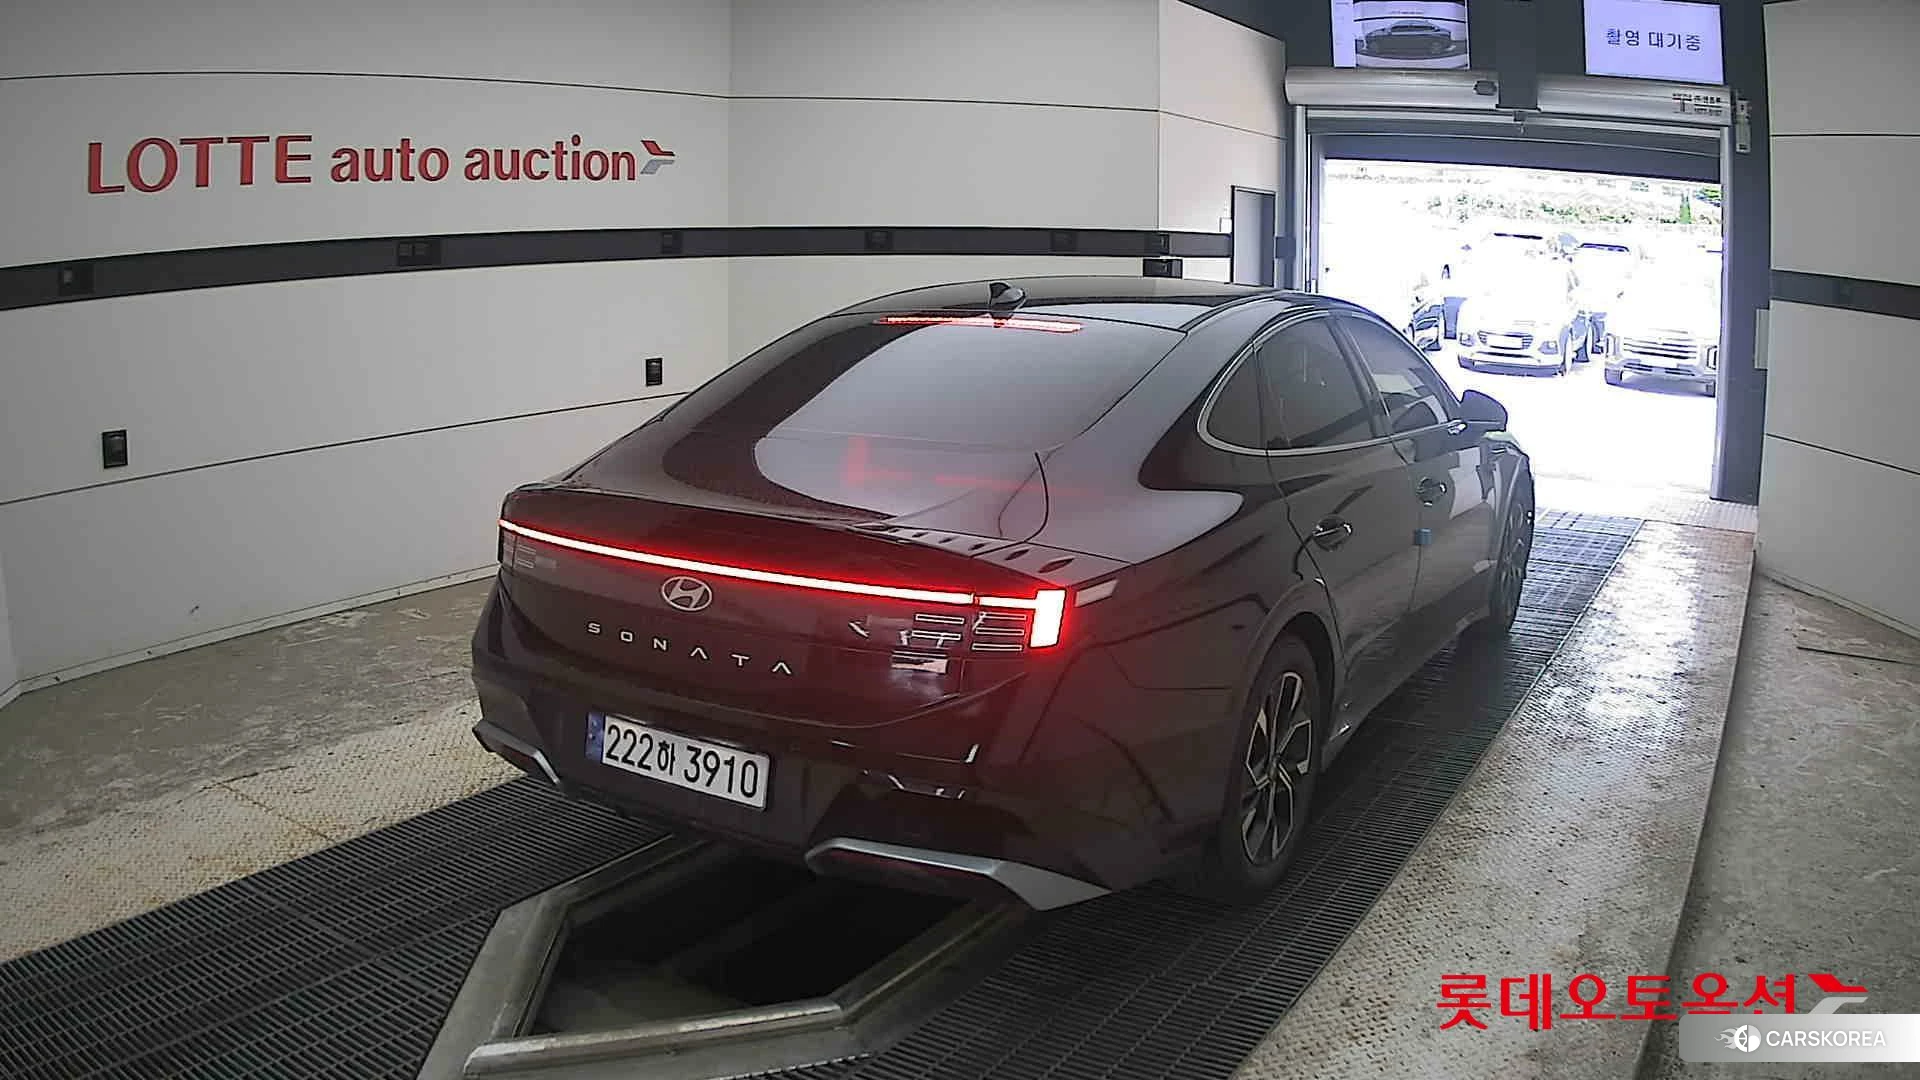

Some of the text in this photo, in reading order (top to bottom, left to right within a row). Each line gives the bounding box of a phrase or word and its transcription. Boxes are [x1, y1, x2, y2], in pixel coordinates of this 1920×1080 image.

[1648, 31, 1700, 51] 대기중
[87, 135, 636, 194] LOTTE auto auction
[587, 622, 792, 675] SONATA
[605, 724, 759, 798] 222하 3910
